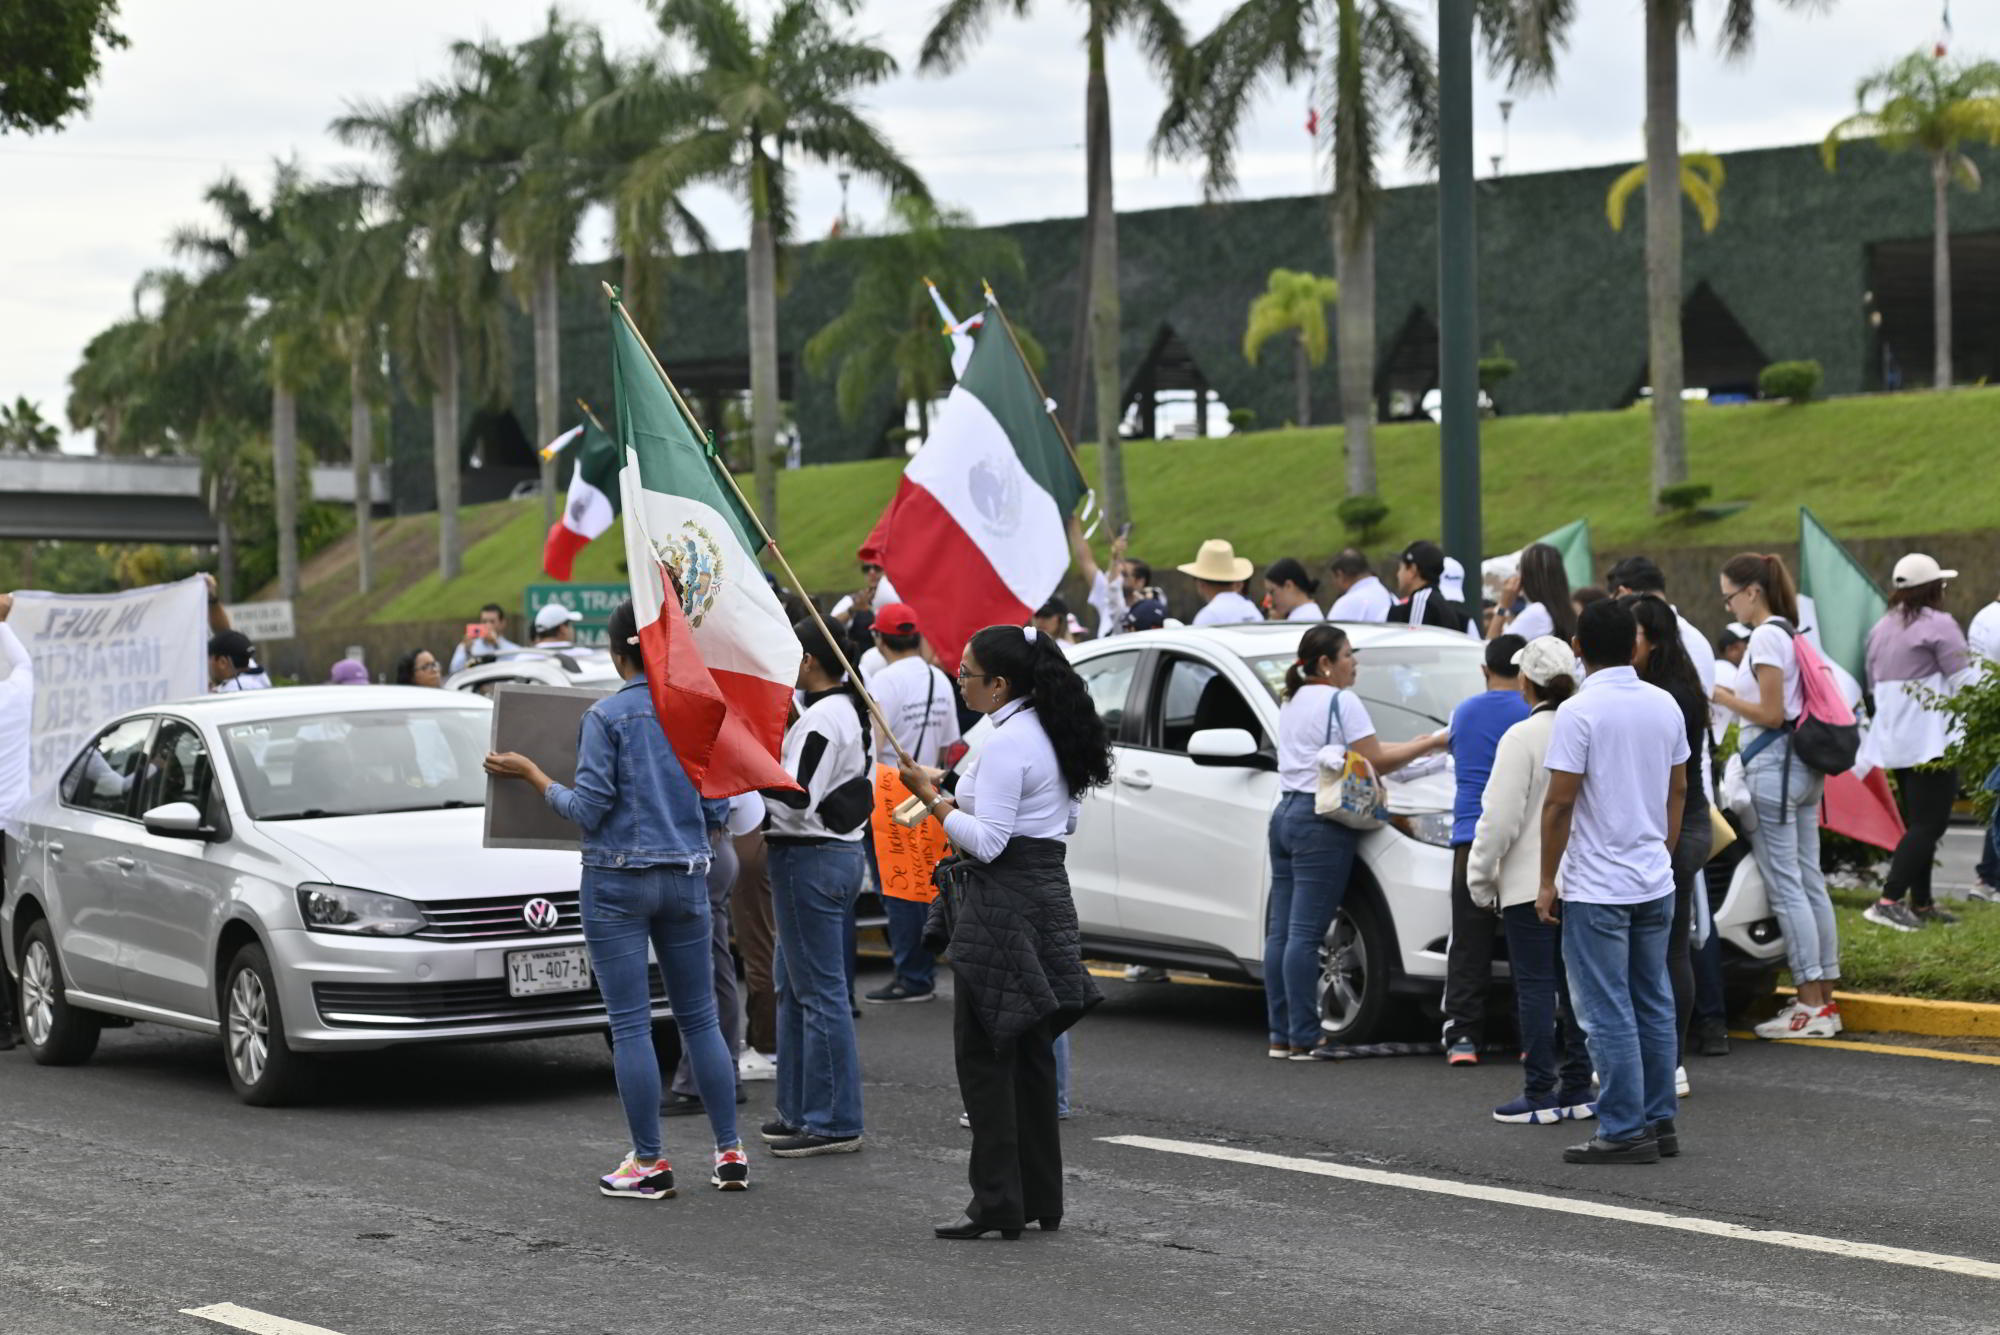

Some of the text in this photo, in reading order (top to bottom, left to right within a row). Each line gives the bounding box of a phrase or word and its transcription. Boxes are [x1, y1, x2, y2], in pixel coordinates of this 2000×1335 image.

[532, 591, 576, 611] LAS
[531, 950, 566, 960] VERACRUZ
[512, 957, 587, 983] YJL-407-A
